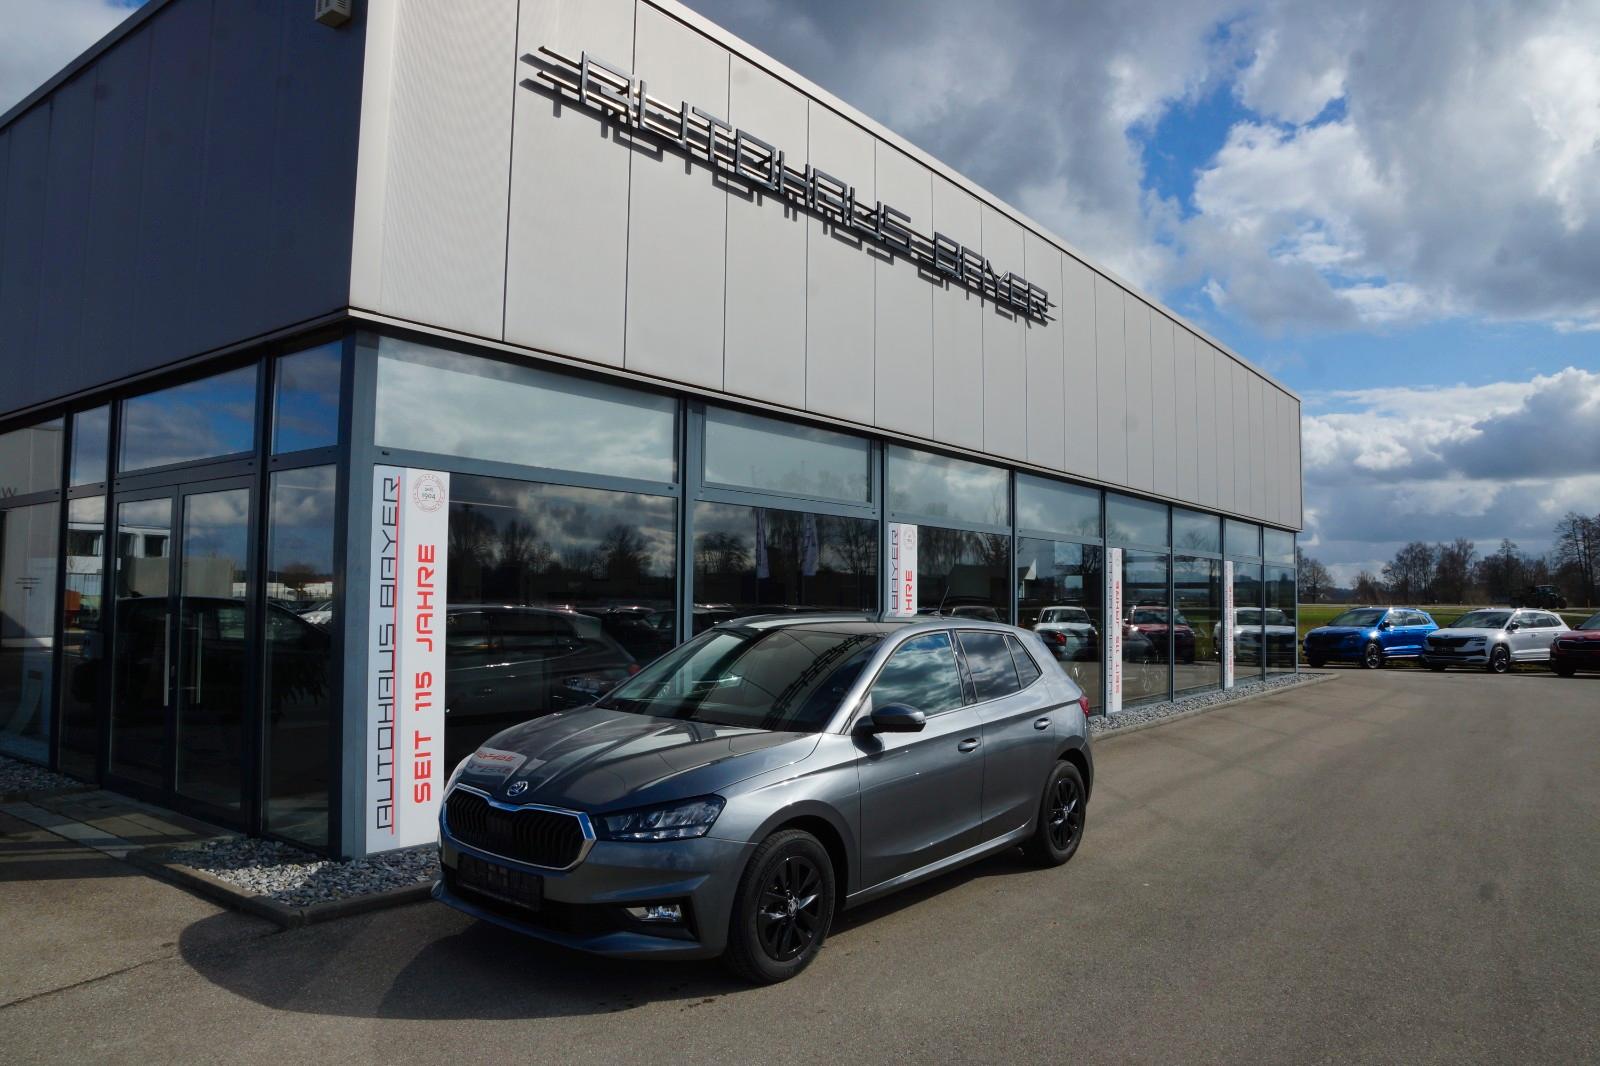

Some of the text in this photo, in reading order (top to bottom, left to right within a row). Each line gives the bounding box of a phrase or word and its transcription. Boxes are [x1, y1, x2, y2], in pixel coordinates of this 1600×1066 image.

[578, 51, 1048, 322] AUTOHAUS BAYER
[376, 477, 399, 830] AUTOHAUS BAYER
[414, 544, 436, 804] SEIT 115 JAHRE
[905, 570, 913, 614] HRE
